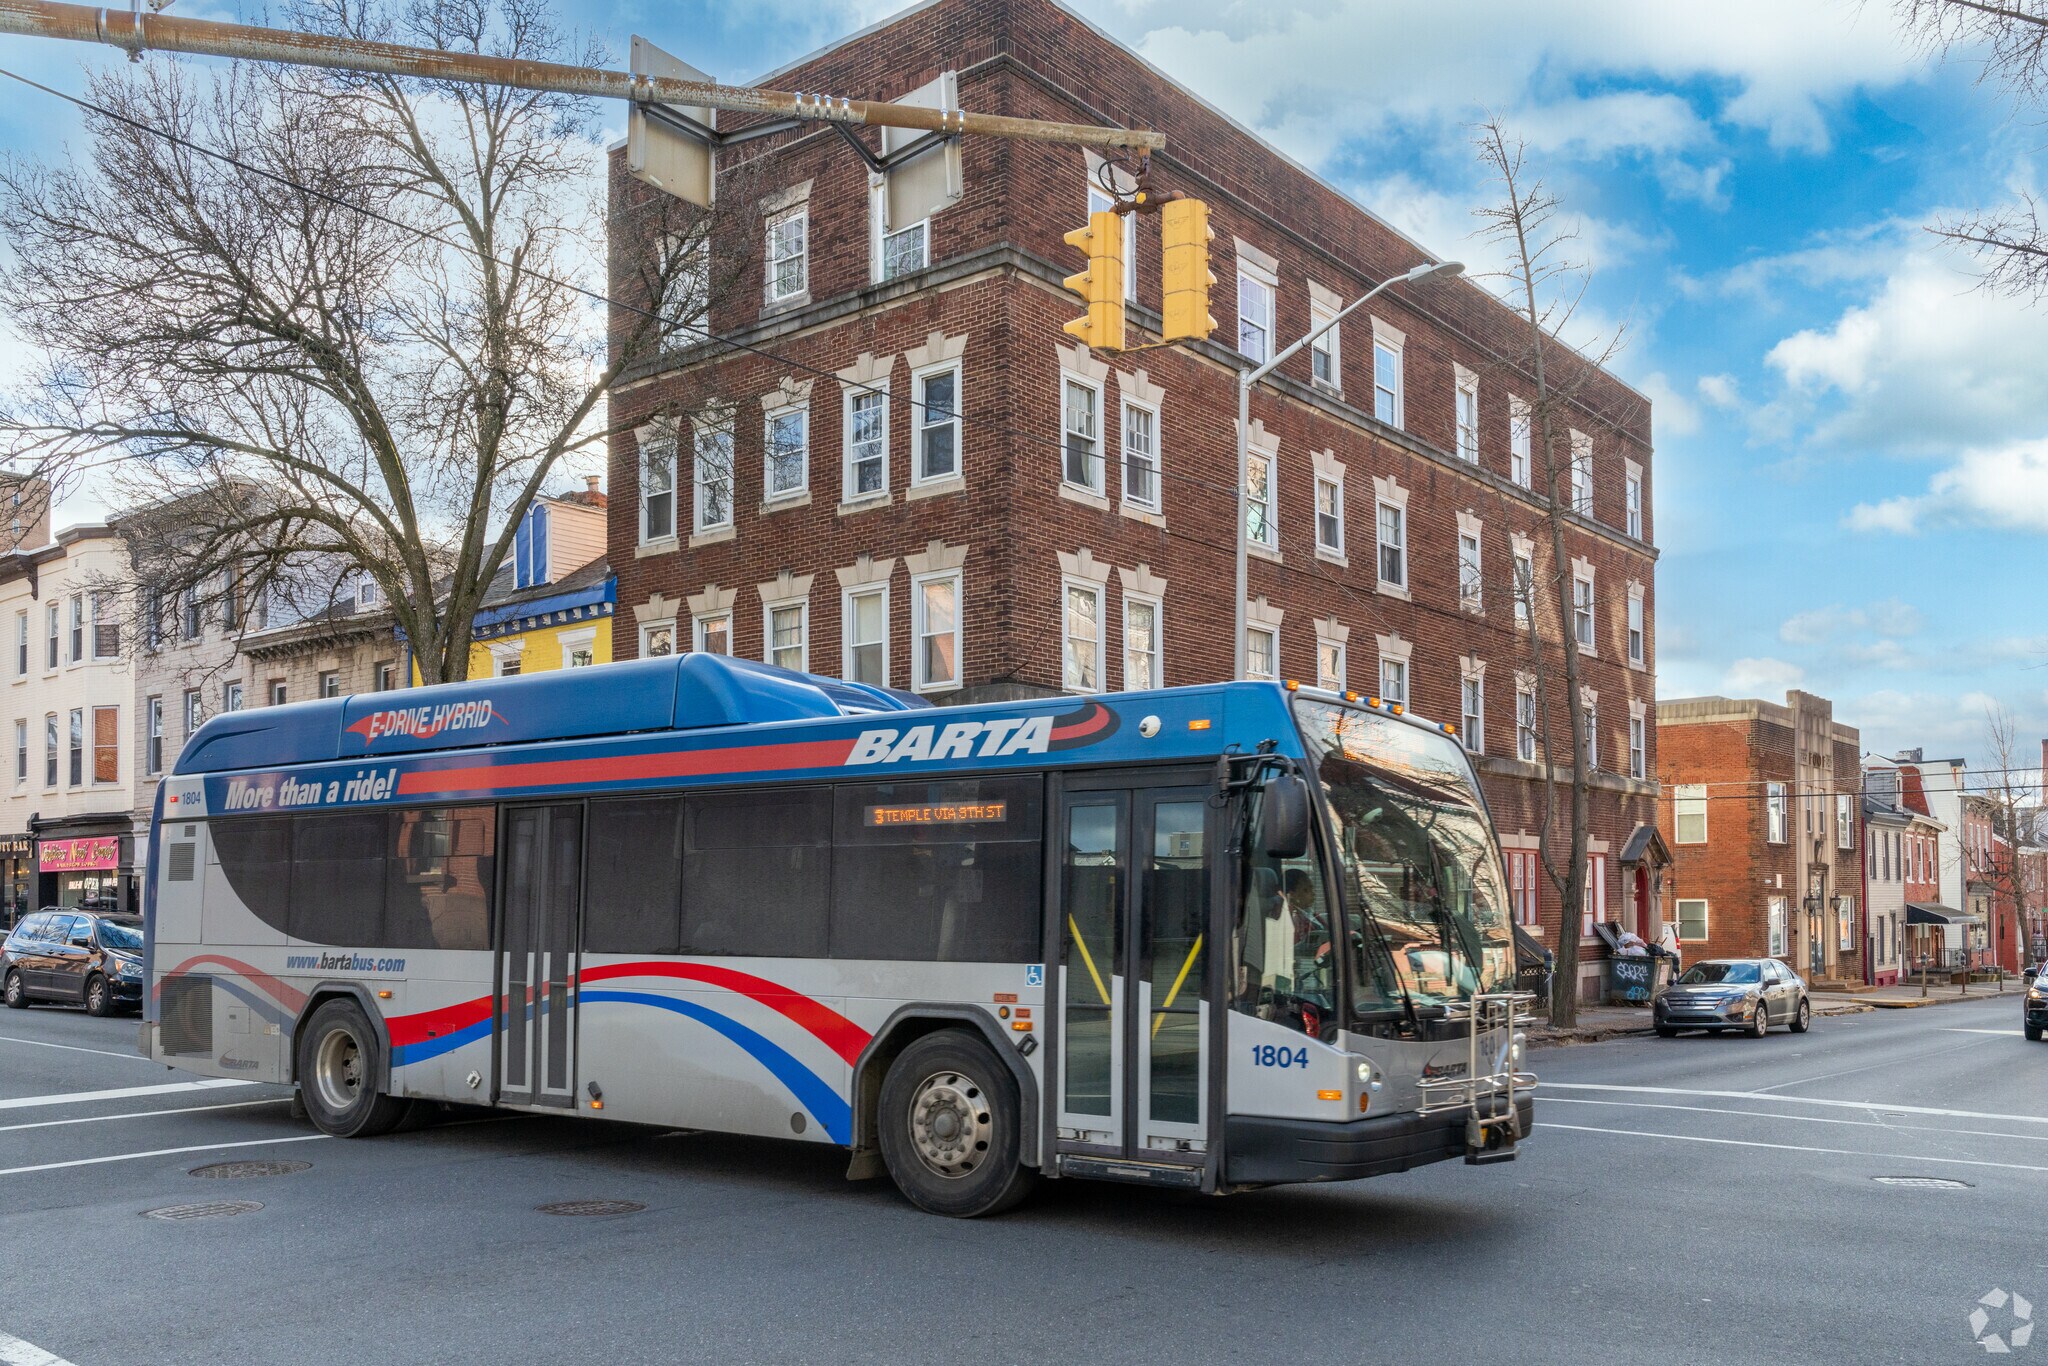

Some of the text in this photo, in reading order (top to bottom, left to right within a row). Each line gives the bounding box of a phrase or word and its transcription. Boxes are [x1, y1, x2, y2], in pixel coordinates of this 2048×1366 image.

[369, 699, 493, 738] E-DRIVE HYBRID
[844, 716, 1055, 766] BARTA
[182, 791, 201, 805] 1804
[224, 768, 397, 810] More than a ride!
[885, 808, 931, 822] TEMPLE
[934, 807, 956, 820] VIA
[986, 804, 1004, 818] ST
[286, 952, 406, 972] www.bartabus.com
[1252, 1044, 1309, 1069] 1804
